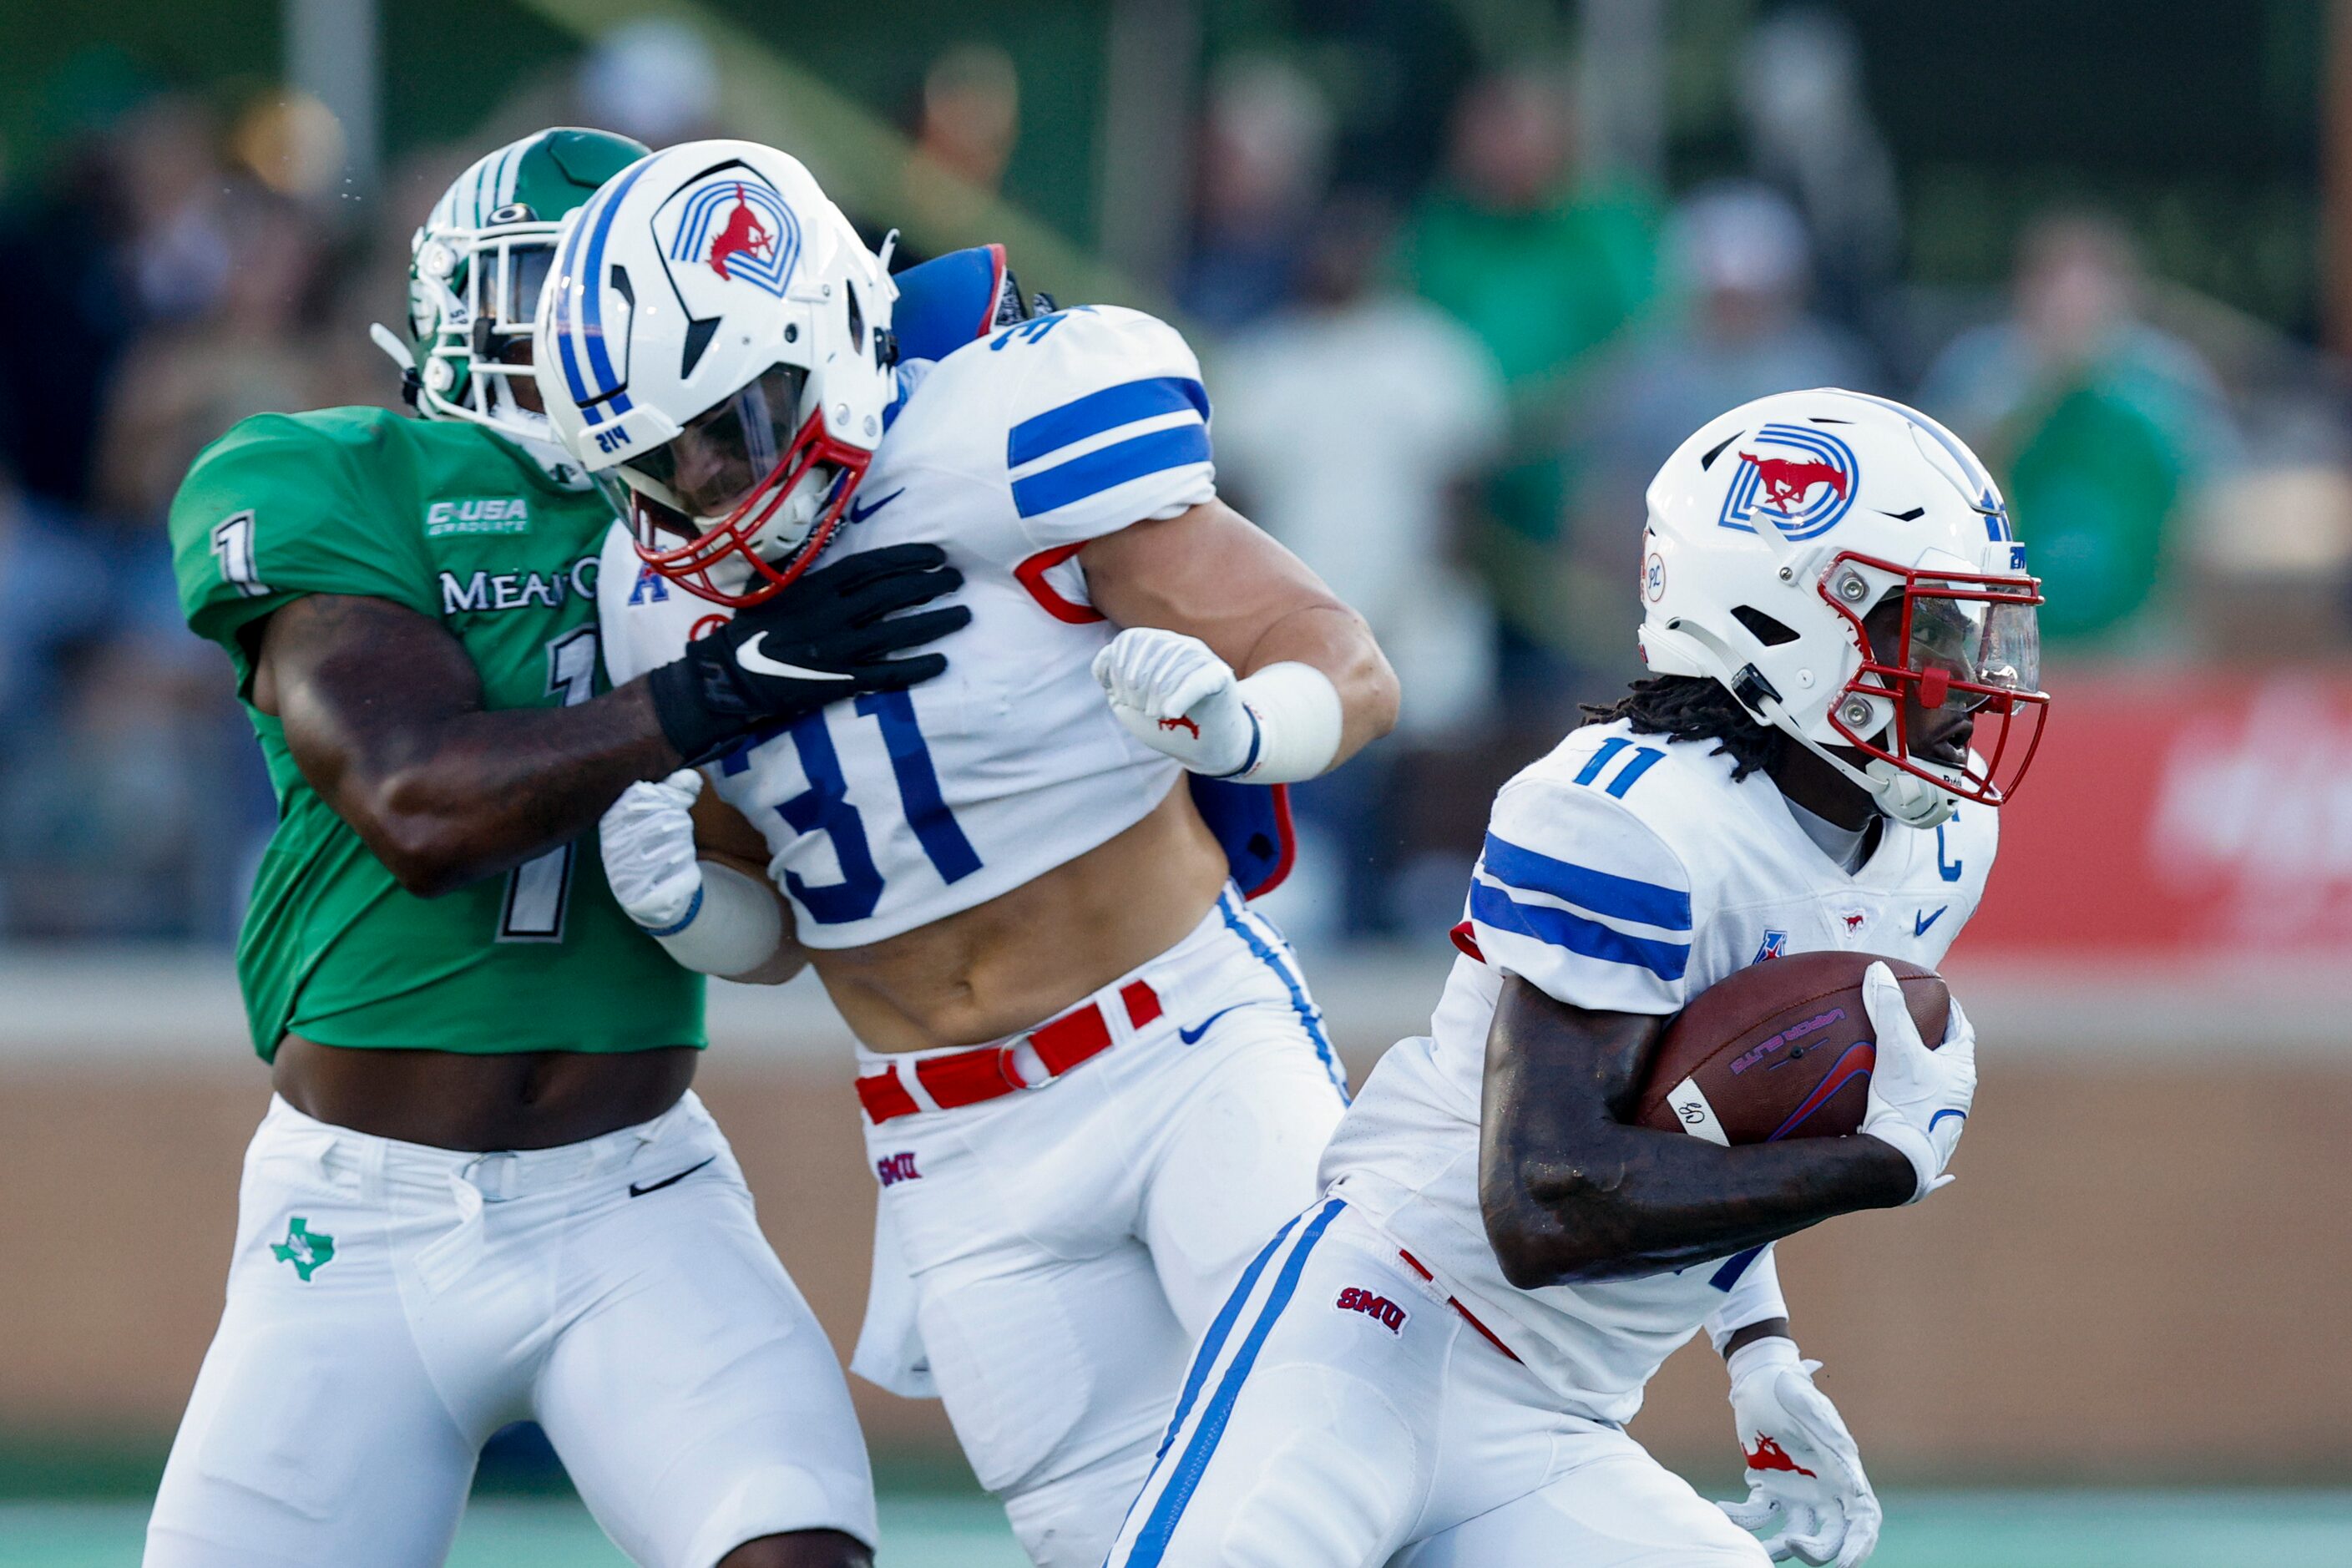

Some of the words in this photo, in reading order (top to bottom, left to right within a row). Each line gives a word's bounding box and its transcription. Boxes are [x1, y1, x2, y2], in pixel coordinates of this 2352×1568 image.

[210, 508, 271, 598] 1
[711, 689, 984, 924] 31
[1572, 736, 1667, 800] 11
[1337, 1287, 1406, 1331] SMU
